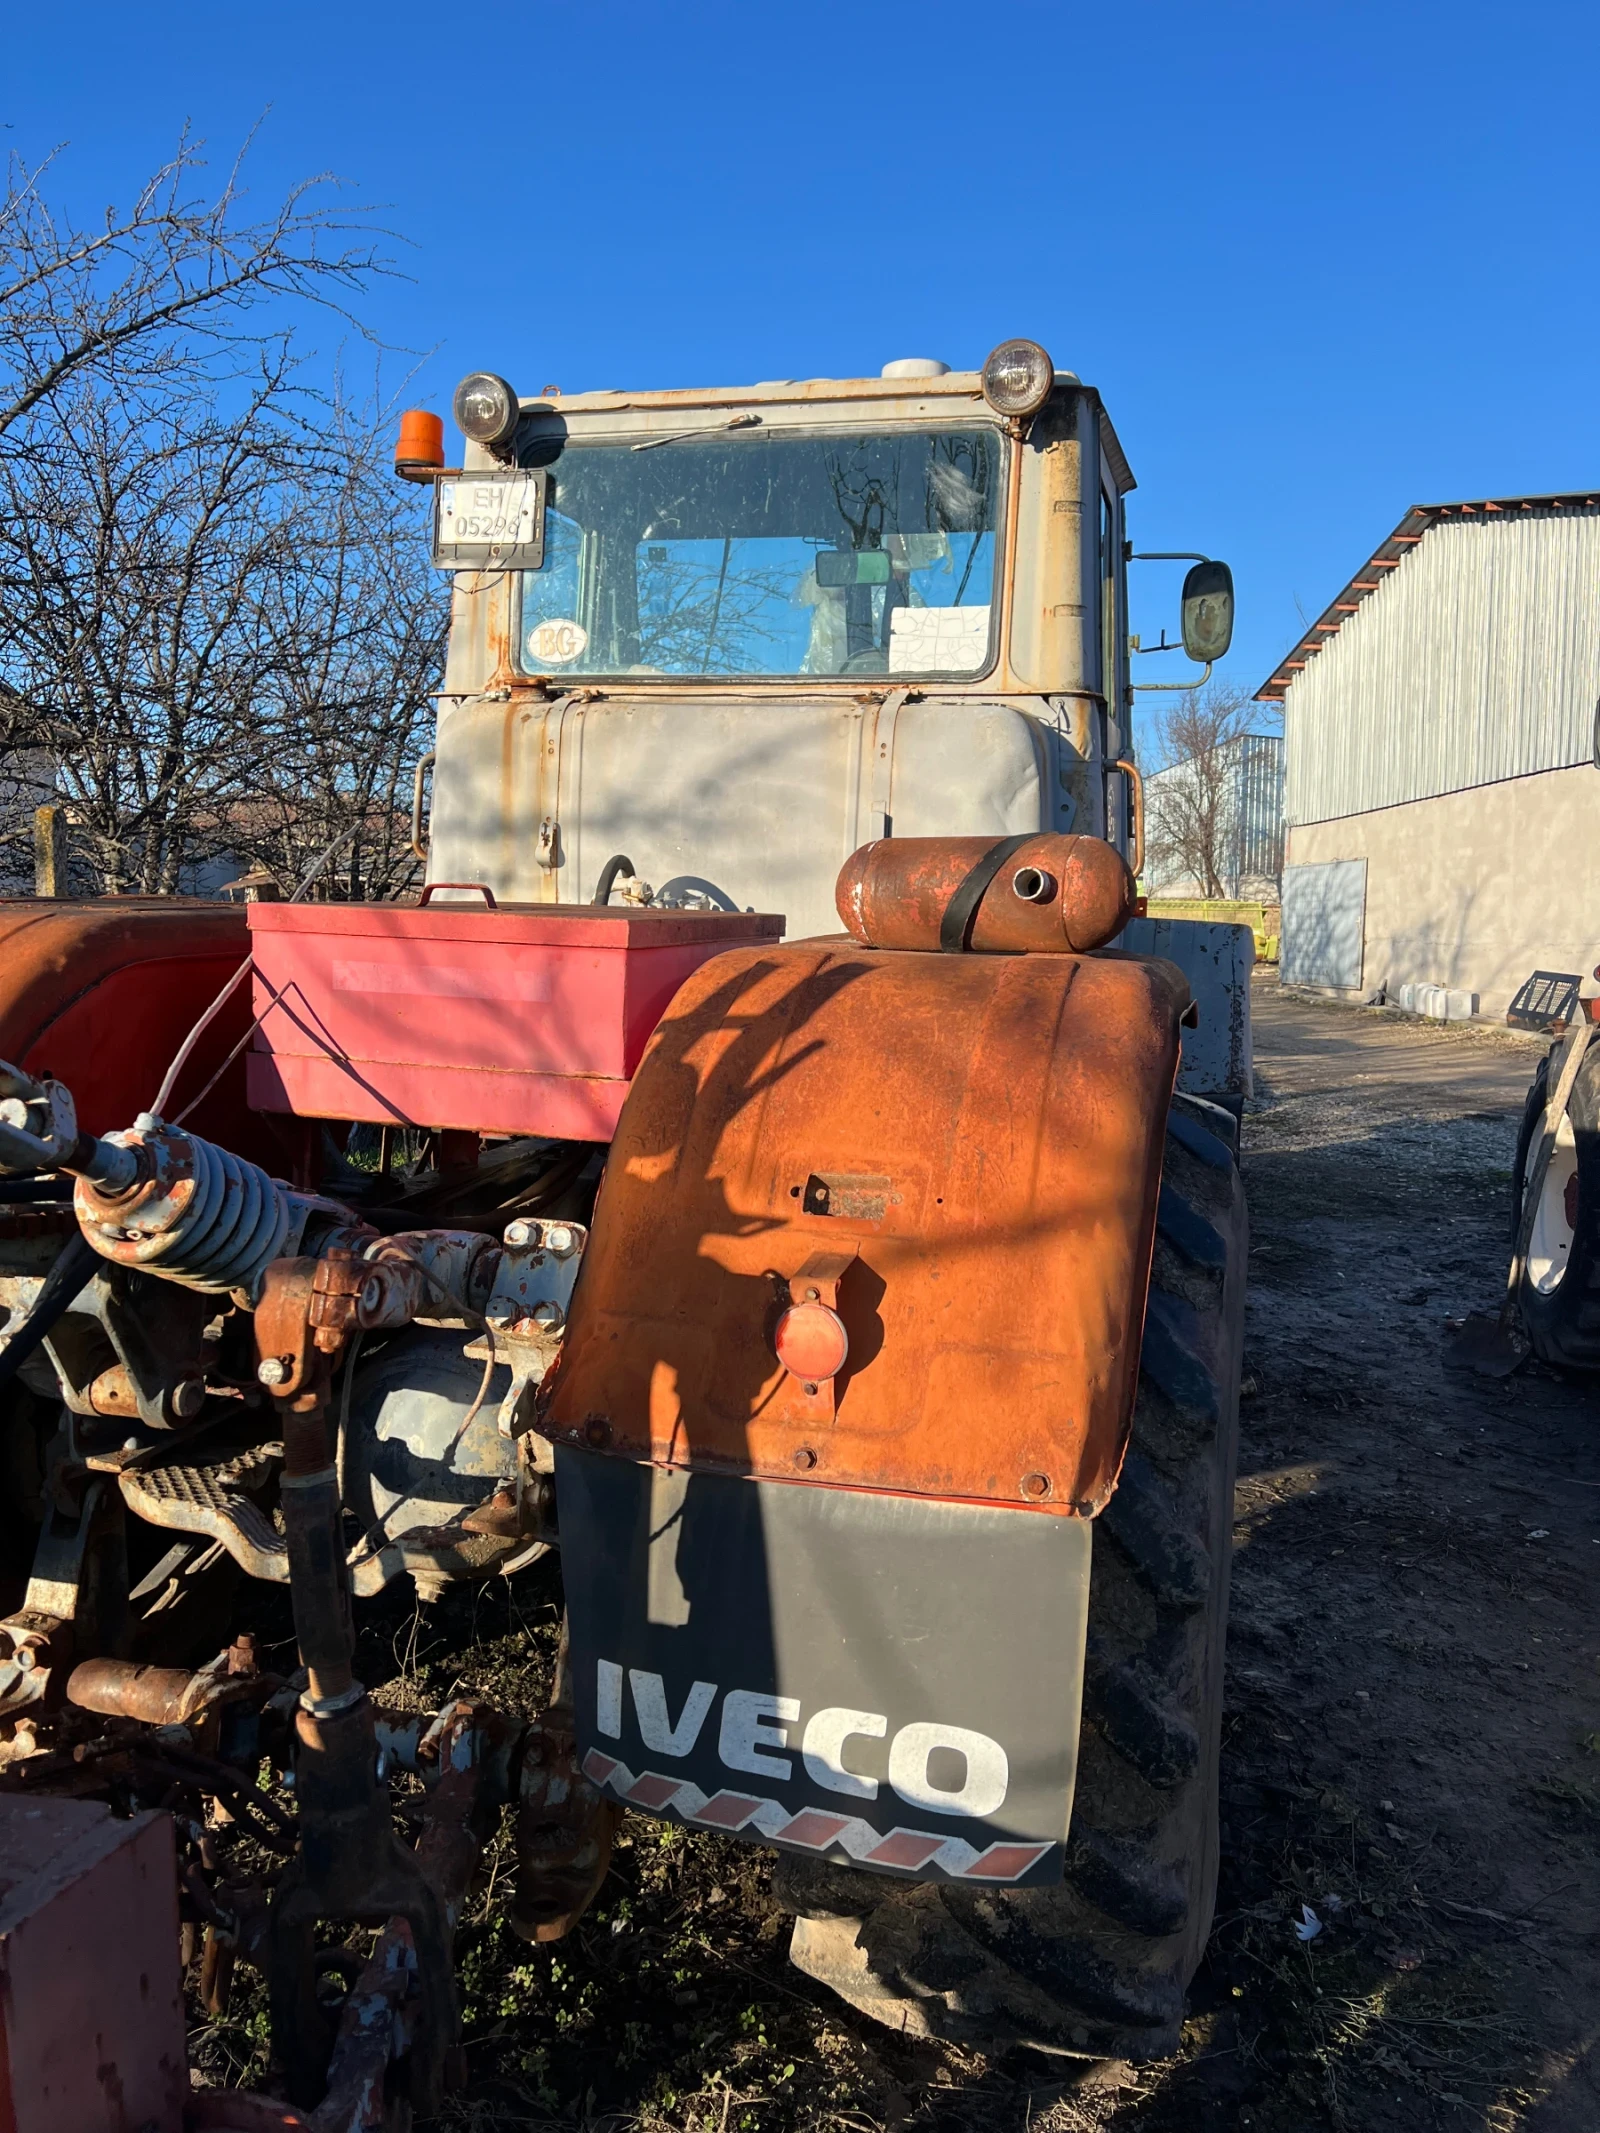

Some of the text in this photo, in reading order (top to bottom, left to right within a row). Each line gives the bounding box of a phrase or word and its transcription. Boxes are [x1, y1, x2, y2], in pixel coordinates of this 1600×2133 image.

[474, 487, 503, 509] EH
[454, 515, 519, 538] 05296
[538, 626, 576, 657] BG
[597, 1659, 1009, 1818] IVECO
